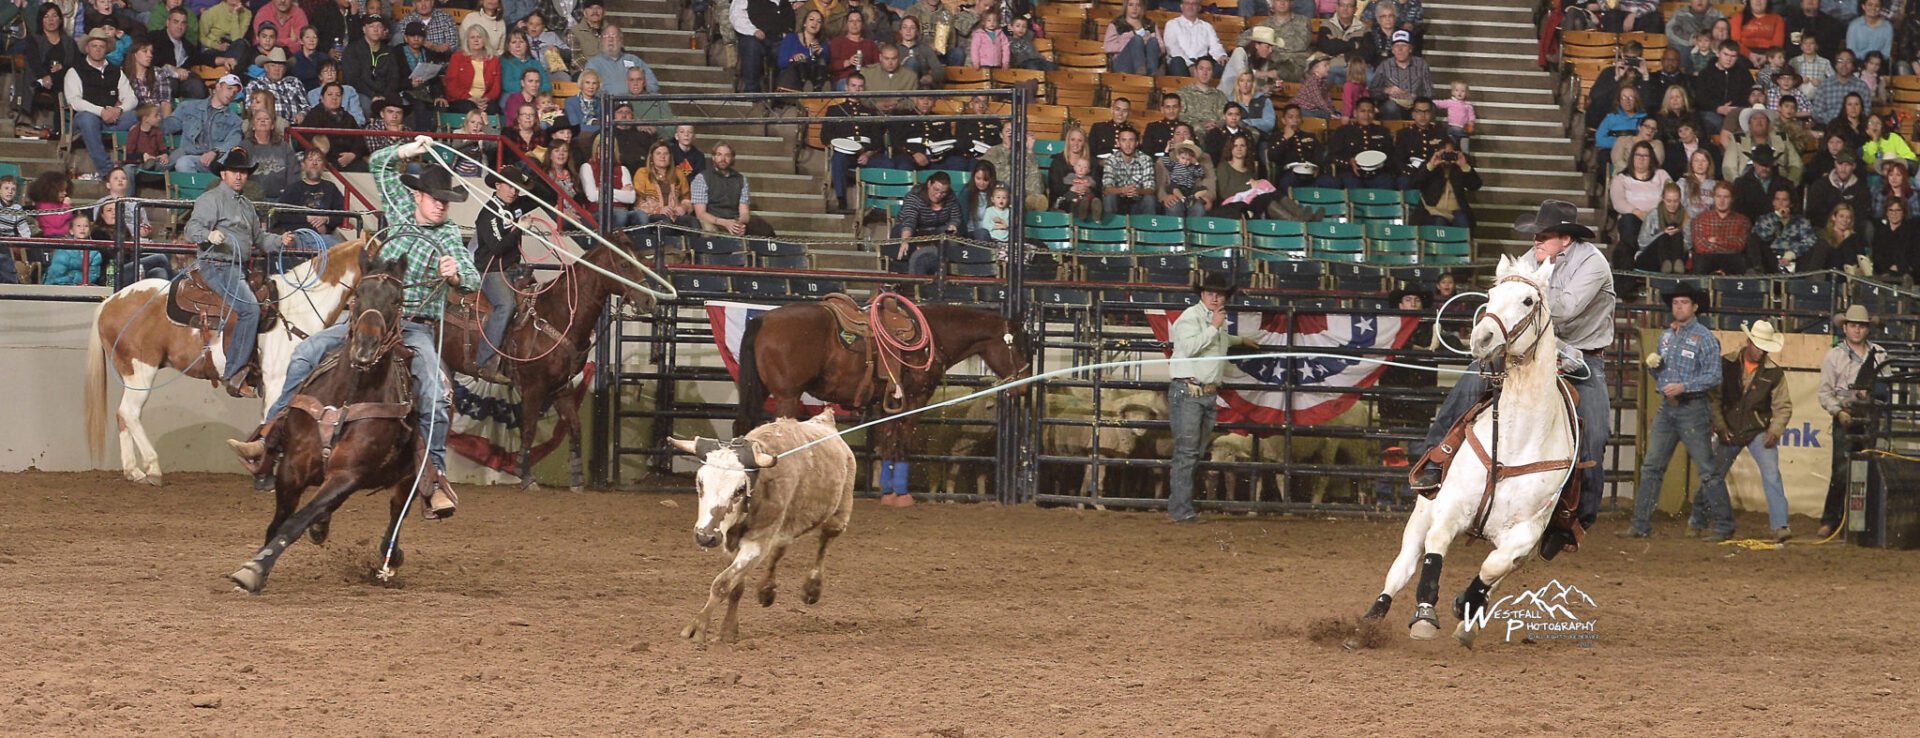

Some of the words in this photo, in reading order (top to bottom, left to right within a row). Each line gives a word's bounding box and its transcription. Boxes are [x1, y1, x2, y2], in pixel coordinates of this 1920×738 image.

[1046, 143, 1053, 152] 4
[1313, 191, 1320, 199] 8
[1368, 192, 1376, 201] 9
[1036, 215, 1042, 223] 3
[1151, 218, 1158, 227] 5
[1208, 221, 1215, 230] 6
[1270, 222, 1276, 231] 7
[1329, 225, 1336, 234] 8
[1384, 227, 1391, 236] 9
[1436, 229, 1446, 238] 10
[645, 238, 652, 247] 8
[706, 241, 713, 250] 9
[767, 242, 777, 252] 10
[43, 252, 49, 262] 7
[962, 250, 969, 259] 2
[1100, 256, 1108, 265] 4
[1160, 257, 1167, 266] 5
[1221, 260, 1229, 269] 6
[1292, 263, 1298, 273] 7
[1353, 265, 1360, 274] 8
[1414, 268, 1421, 277] 9
[693, 279, 700, 288] 8
[751, 281, 758, 290] 9
[808, 283, 818, 292] 10
[1737, 282, 1744, 290] 2
[1812, 285, 1818, 294] 3
[1872, 286, 1879, 296] 4
[998, 290, 1005, 299] 2
[1054, 293, 1061, 302] 3
[1823, 324, 1829, 333] 3
[1776, 422, 1822, 448] nk
